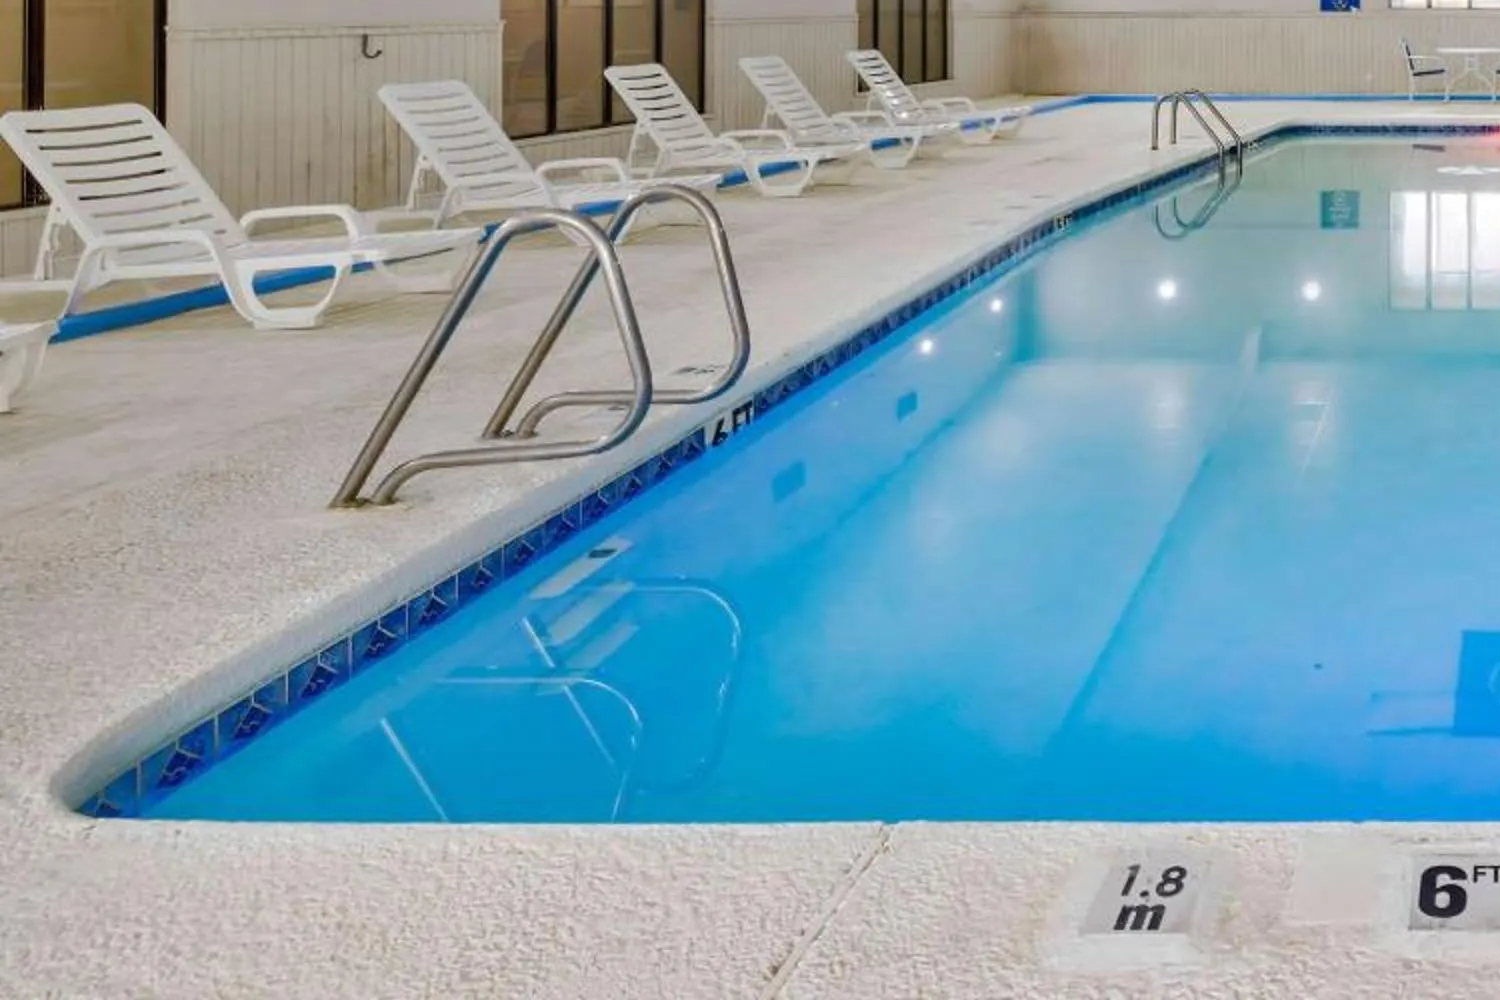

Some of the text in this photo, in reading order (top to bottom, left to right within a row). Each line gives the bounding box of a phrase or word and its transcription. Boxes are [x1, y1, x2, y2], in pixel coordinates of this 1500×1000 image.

[711, 400, 753, 447] 6 FT
[1119, 863, 1187, 898] 1.8
[1418, 865, 1468, 918] 6
[1113, 902, 1166, 931] m
